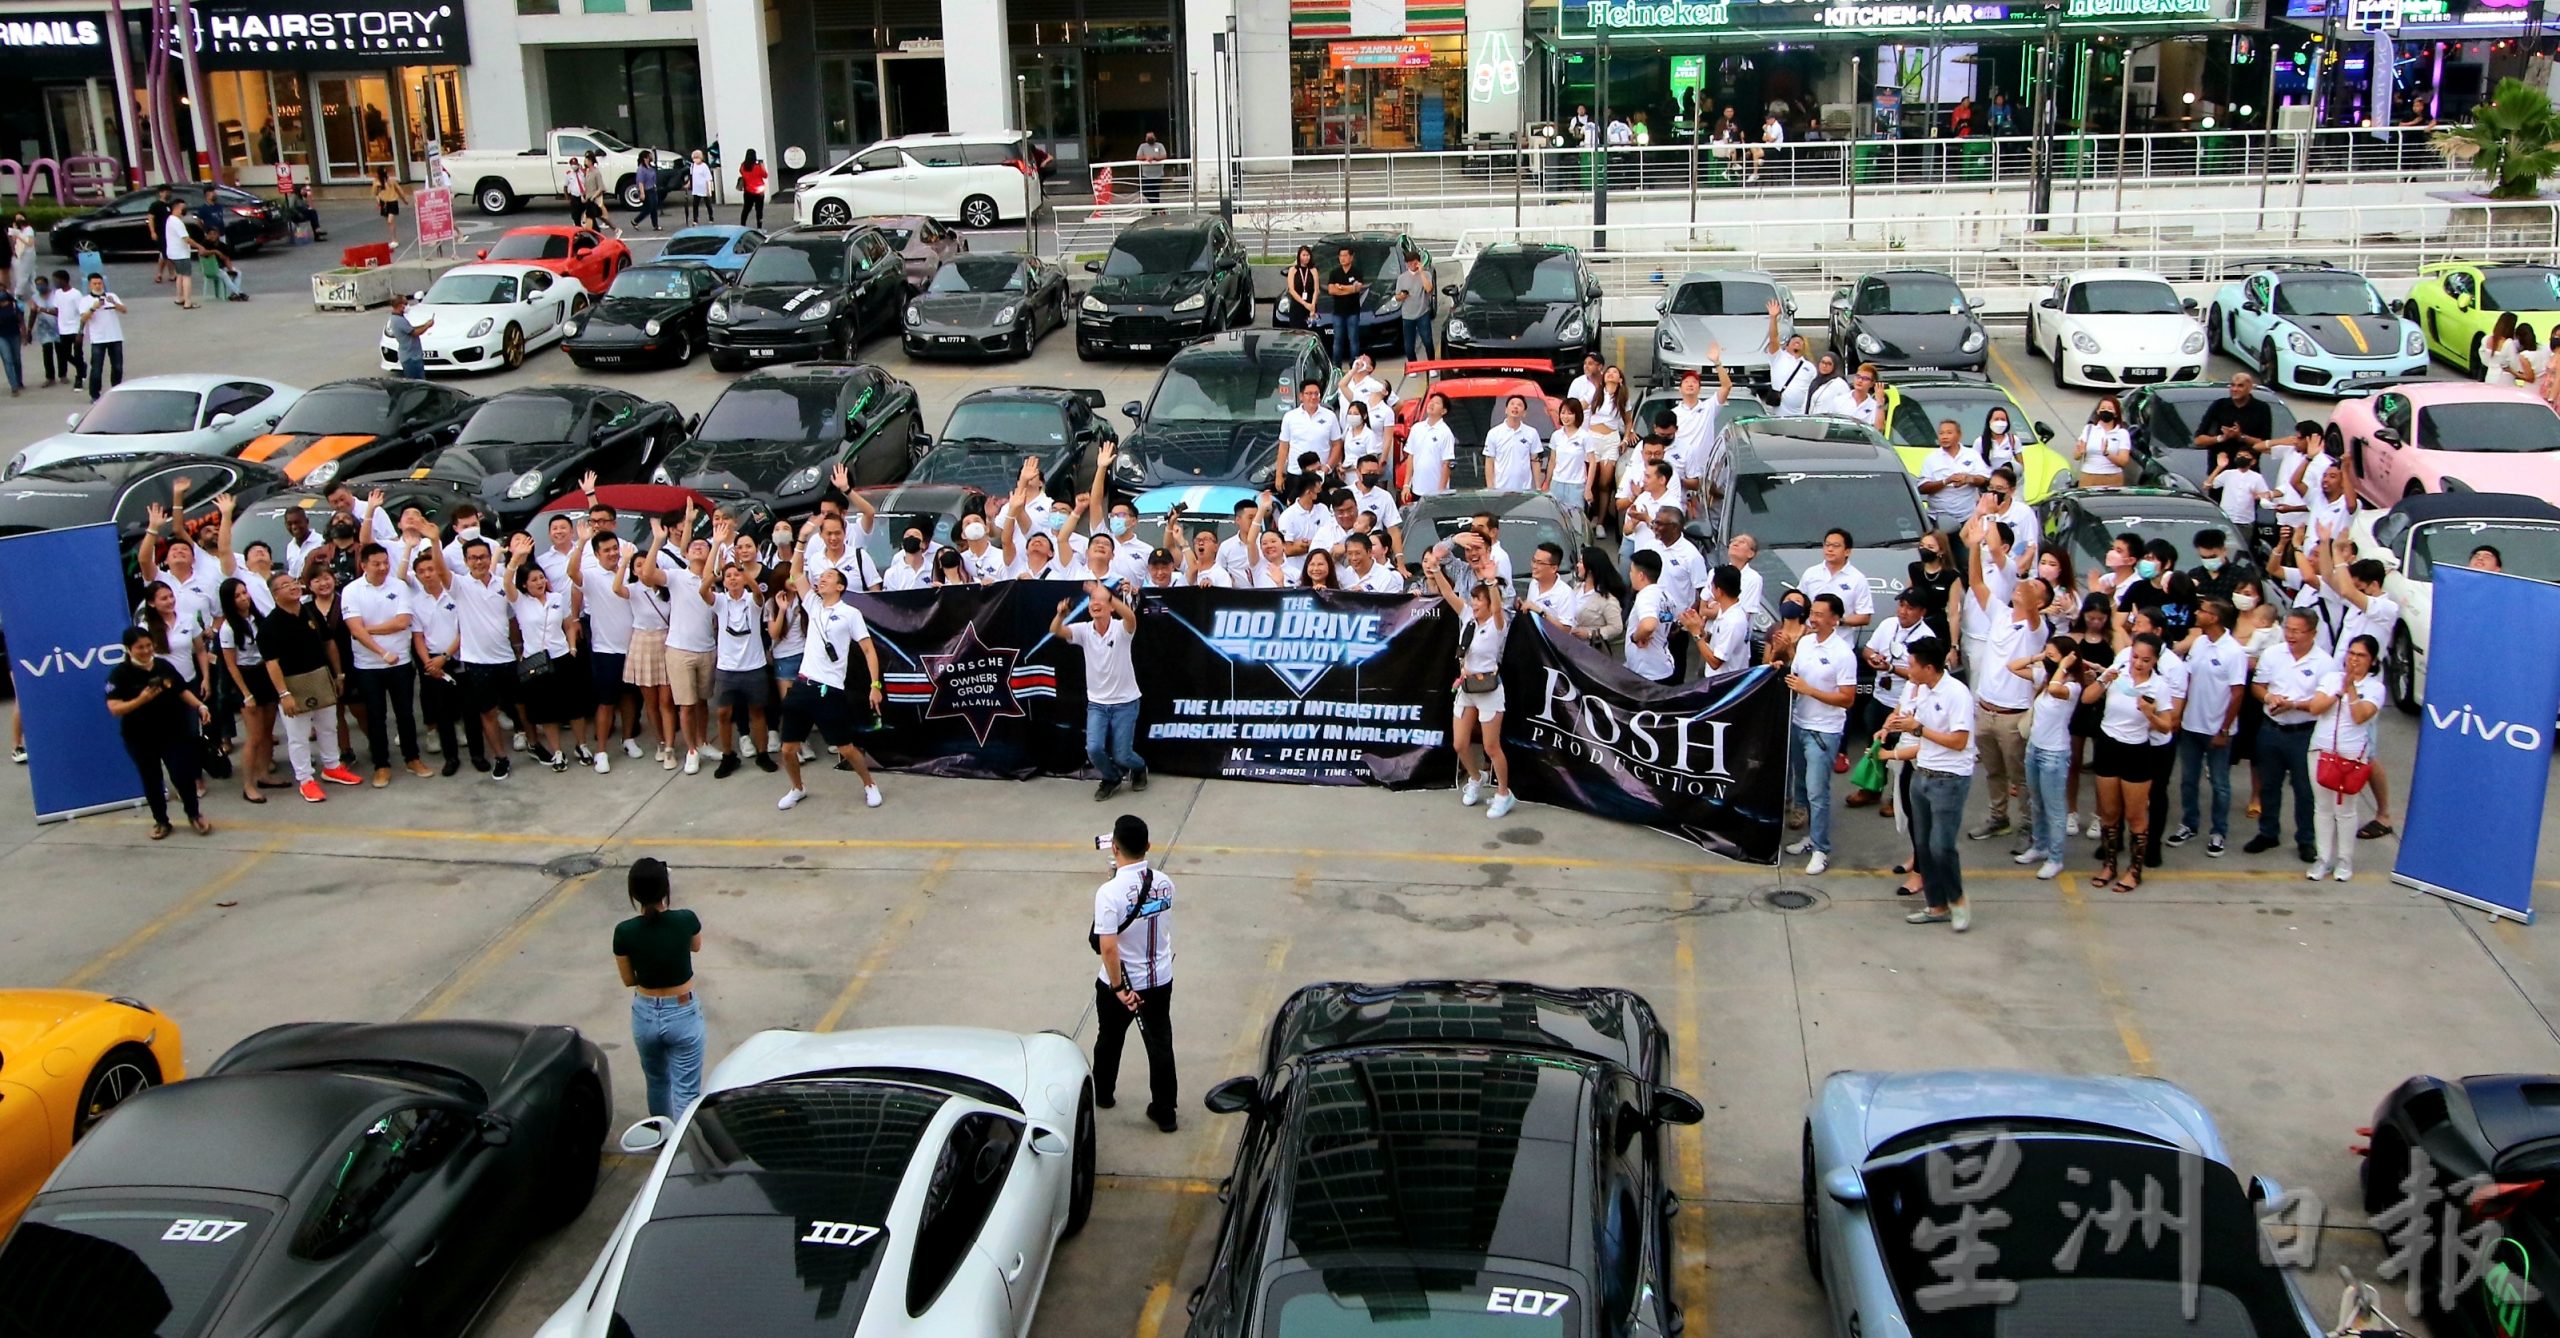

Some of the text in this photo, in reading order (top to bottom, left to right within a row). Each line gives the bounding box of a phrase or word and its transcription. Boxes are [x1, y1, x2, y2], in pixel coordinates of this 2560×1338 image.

[1588, 1, 1729, 27] Heineken
[1825, 6, 1917, 26] KITCHEN
[1282, 596, 1314, 611] THE
[1410, 607, 1441, 617] POSH
[1213, 610, 1382, 643] 100 DRIVE
[20, 643, 127, 678] vivo
[1251, 641, 1346, 662] CONVOY
[938, 656, 1004, 674] PORSCHE
[949, 673, 998, 688] OWNERS
[957, 684, 995, 696] GROUP
[951, 698, 1001, 709] MALAYSIA
[1172, 698, 1424, 721] THE LARGEST INTERSTATE
[1534, 665, 1733, 776] POSH
[2426, 703, 2541, 751] vivo
[1148, 723, 1445, 747] PORSCHE CONVOY IN MALAYSIA
[1230, 747, 1255, 762] KL
[1279, 747, 1364, 762] PENANG
[1531, 726, 1728, 800] PRODUCTION
[1222, 767, 1248, 776] DATE
[1324, 768, 1348, 777] TIME
[160, 1218, 249, 1243] B07
[1486, 1286, 1570, 1317] E07
